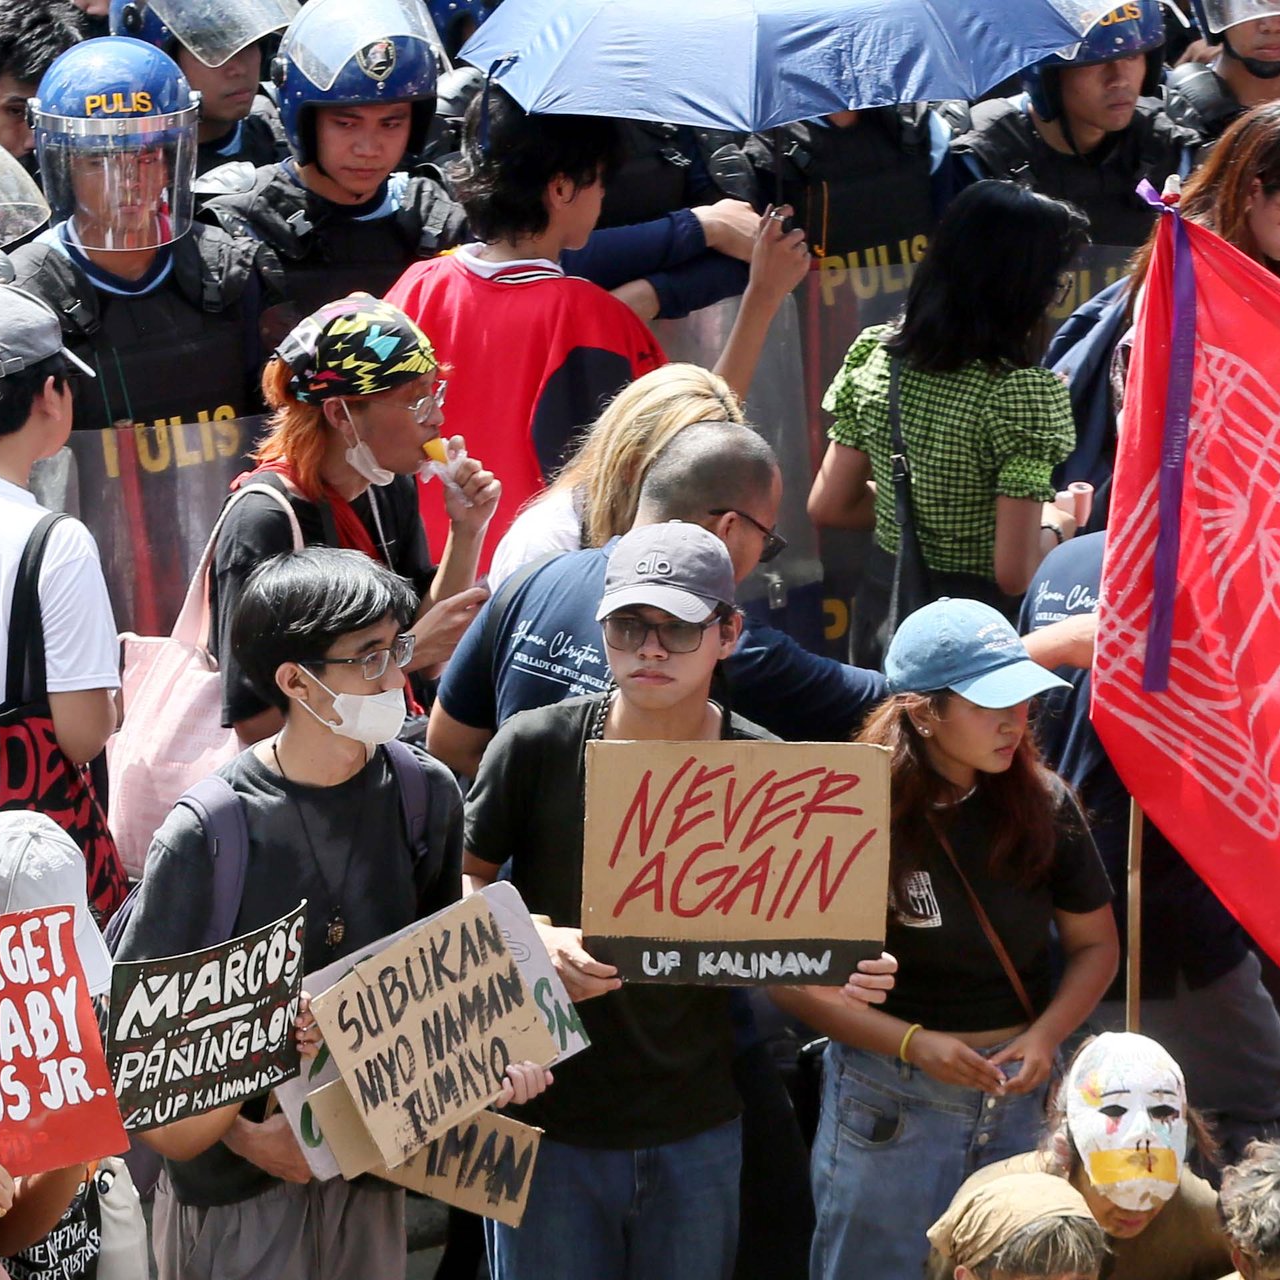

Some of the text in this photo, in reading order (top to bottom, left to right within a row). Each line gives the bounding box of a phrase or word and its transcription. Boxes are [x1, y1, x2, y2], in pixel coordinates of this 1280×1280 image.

[1098, 2, 1141, 26] ULIS
[85, 91, 153, 116] PULIS
[635, 553, 671, 575] alo
[529, 656, 551, 670] LADY
[551, 664, 562, 674] OF
[562, 667, 579, 680] THE
[609, 756, 864, 869] NEVER
[612, 828, 877, 921] AGAIN
[115, 915, 305, 1042] MARCOS
[337, 912, 507, 1053] SUBUKAN
[642, 950, 832, 980] UP KALINAW
[353, 960, 526, 1115] NIYO NAMAN
[38, 1056, 107, 1111] JR.
[154, 1072, 262, 1124] UP KALINAW
[400, 1036, 511, 1142] TUMAYO
